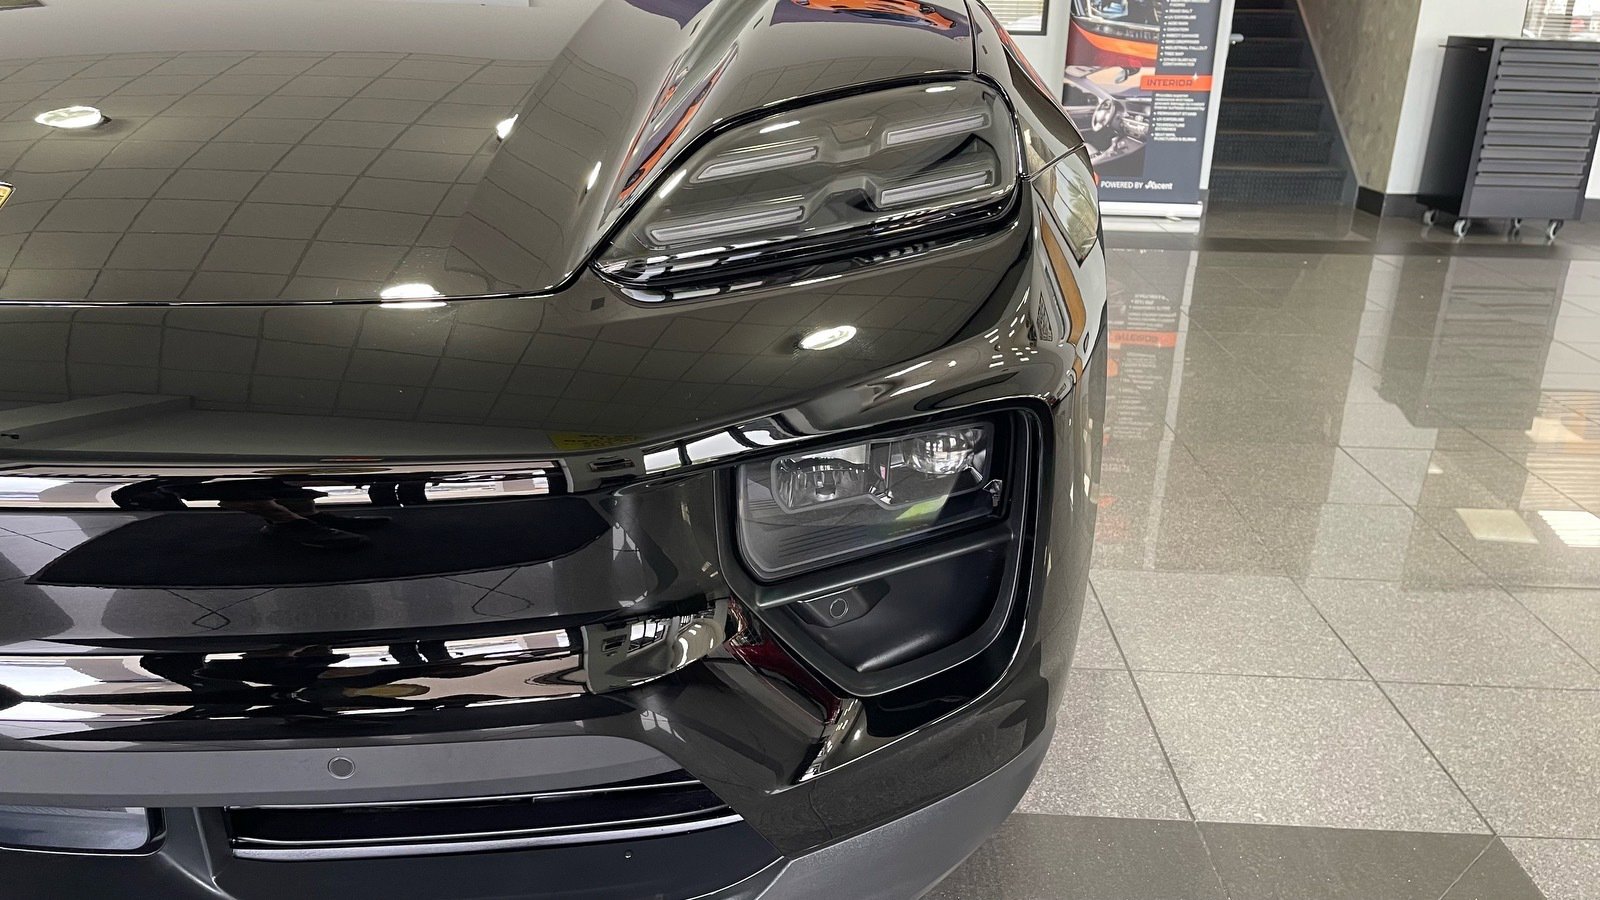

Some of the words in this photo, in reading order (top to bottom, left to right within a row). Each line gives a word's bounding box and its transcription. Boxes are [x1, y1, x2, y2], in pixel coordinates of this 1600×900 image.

[1146, 79, 1193, 87] INTERIOR
[1100, 180, 1133, 189] POWERED
[1134, 181, 1143, 189] BY
